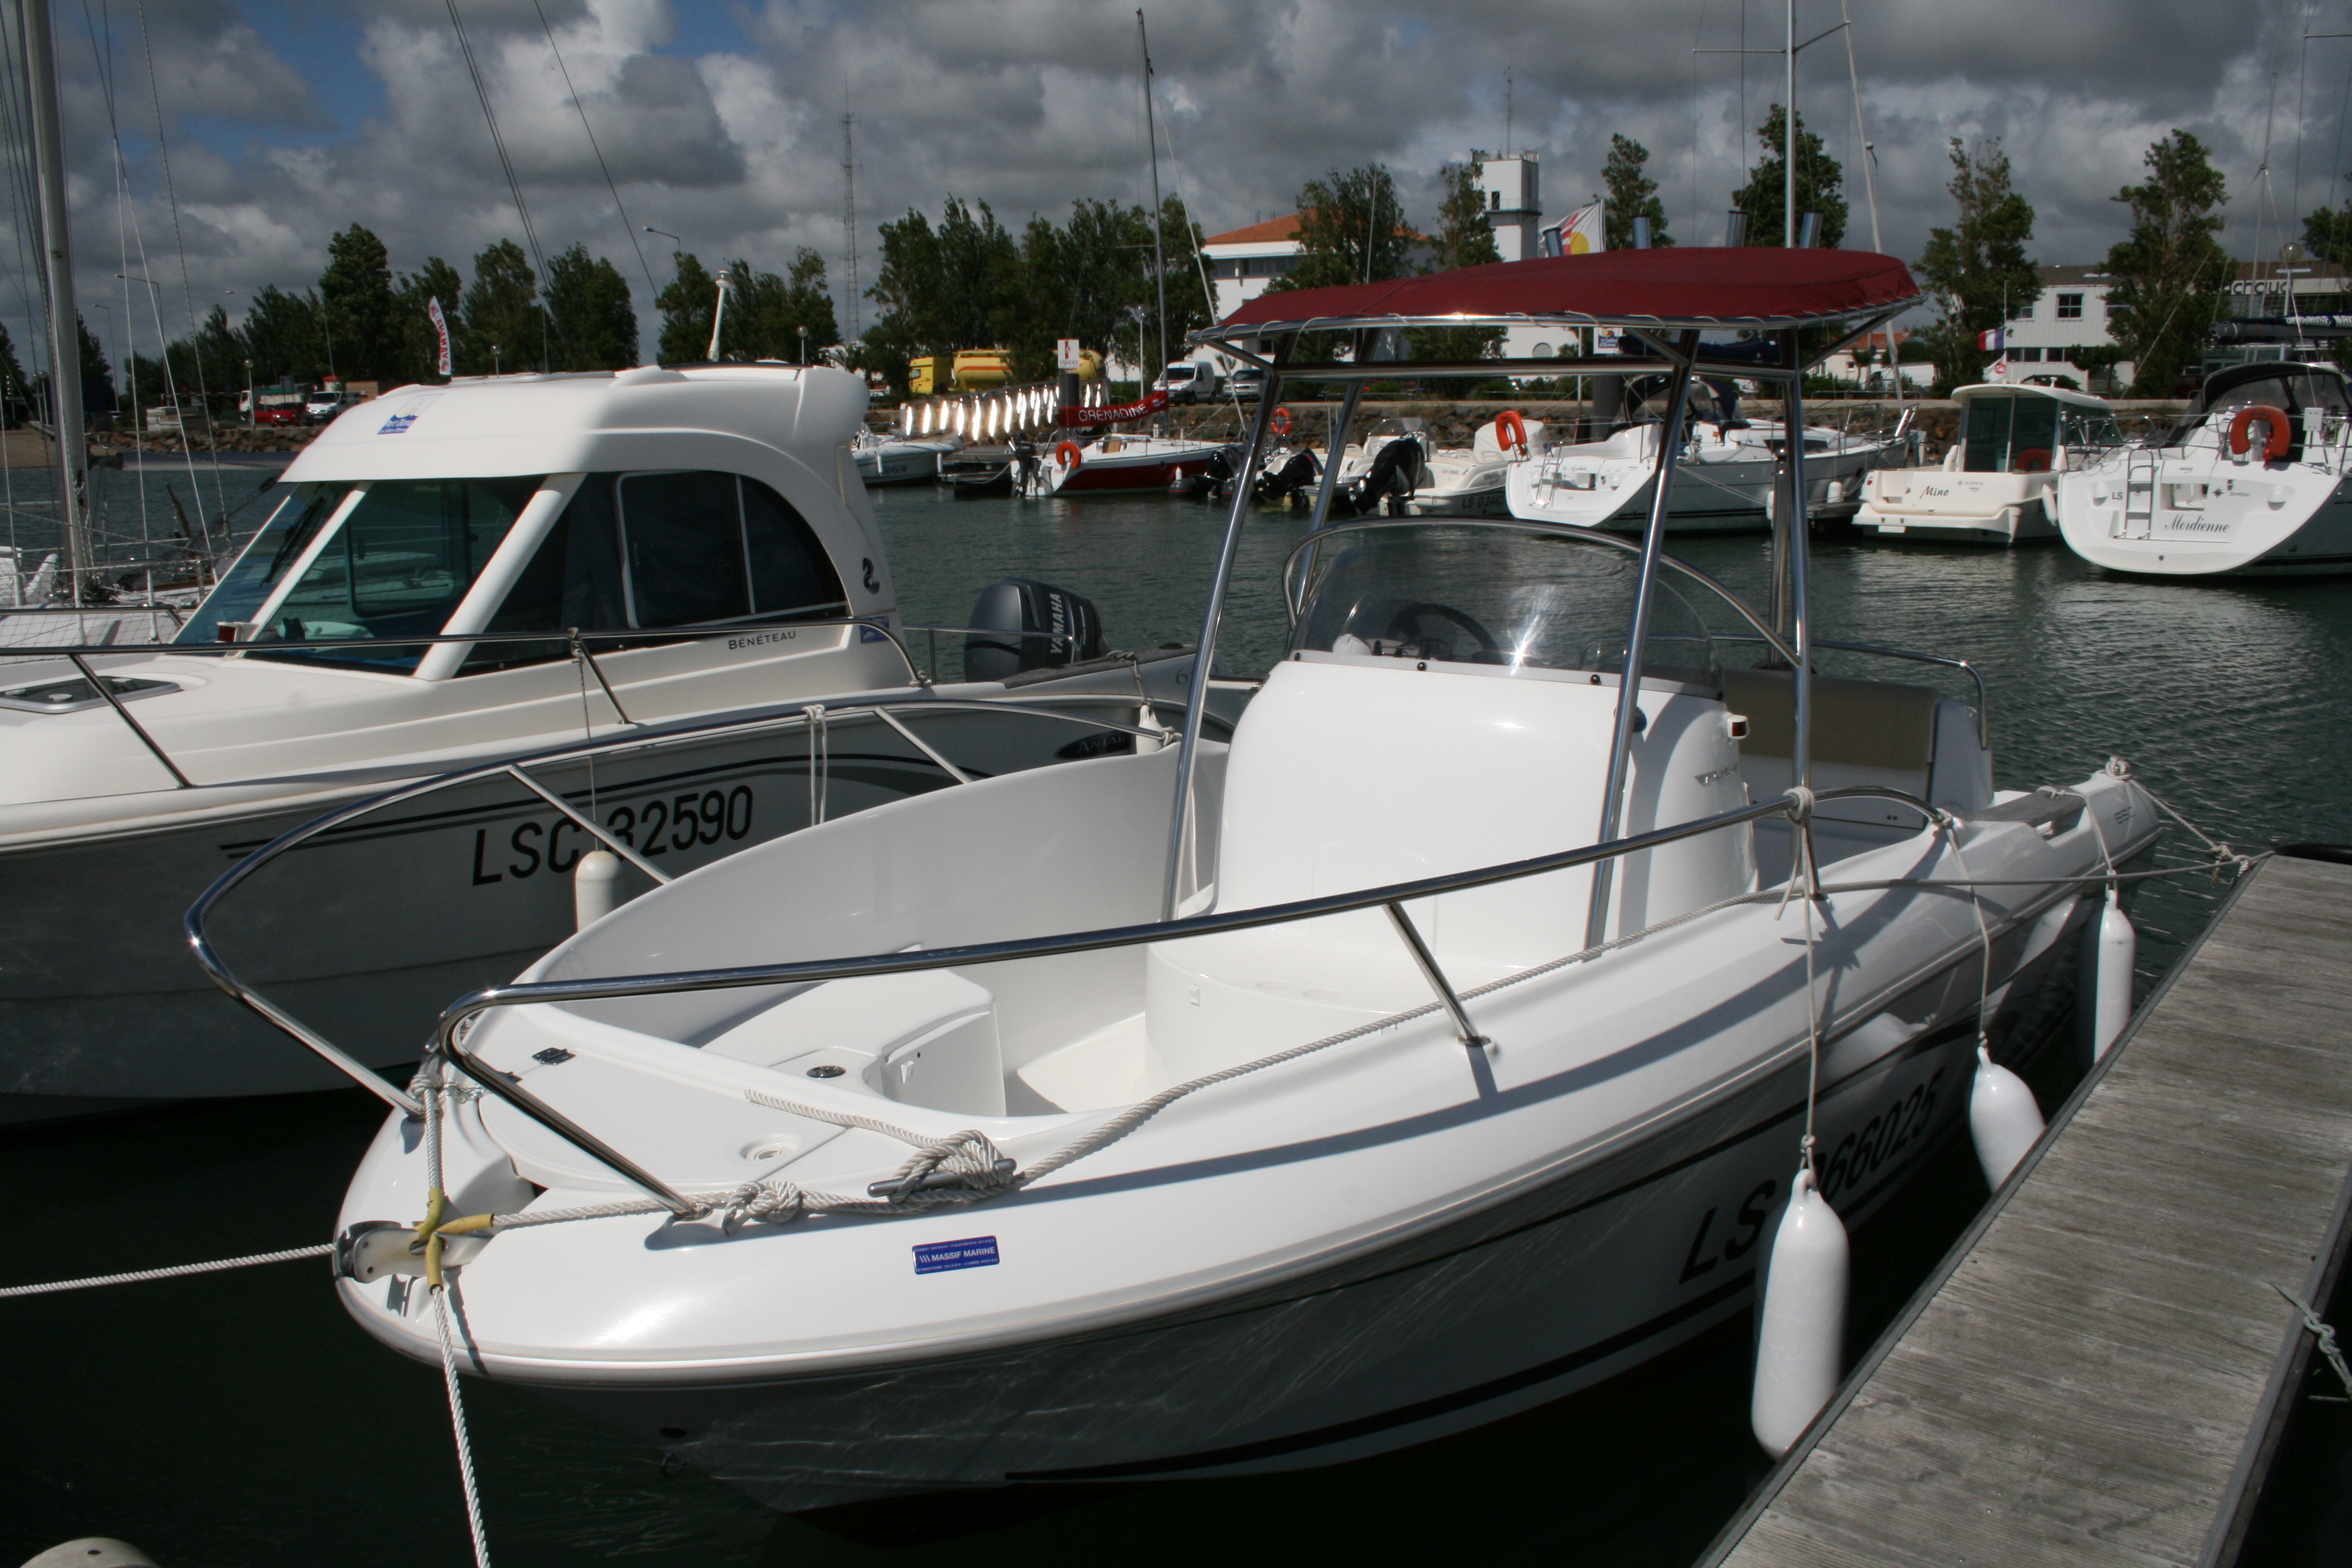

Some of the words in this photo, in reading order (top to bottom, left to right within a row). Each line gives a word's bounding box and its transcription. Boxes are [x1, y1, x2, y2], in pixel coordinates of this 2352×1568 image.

[1079, 403, 1149, 422] GRENADINE
[1919, 486, 1949, 499] Mino
[1462, 497, 1474, 509] LS
[2164, 514, 2229, 533] Mordienne
[1050, 593, 1065, 653] YAMAHA
[472, 817, 581, 886] LSC
[606, 785, 753, 861] 32590
[931, 1251, 962, 1262] MASSIF
[963, 1246, 996, 1258] MARINE
